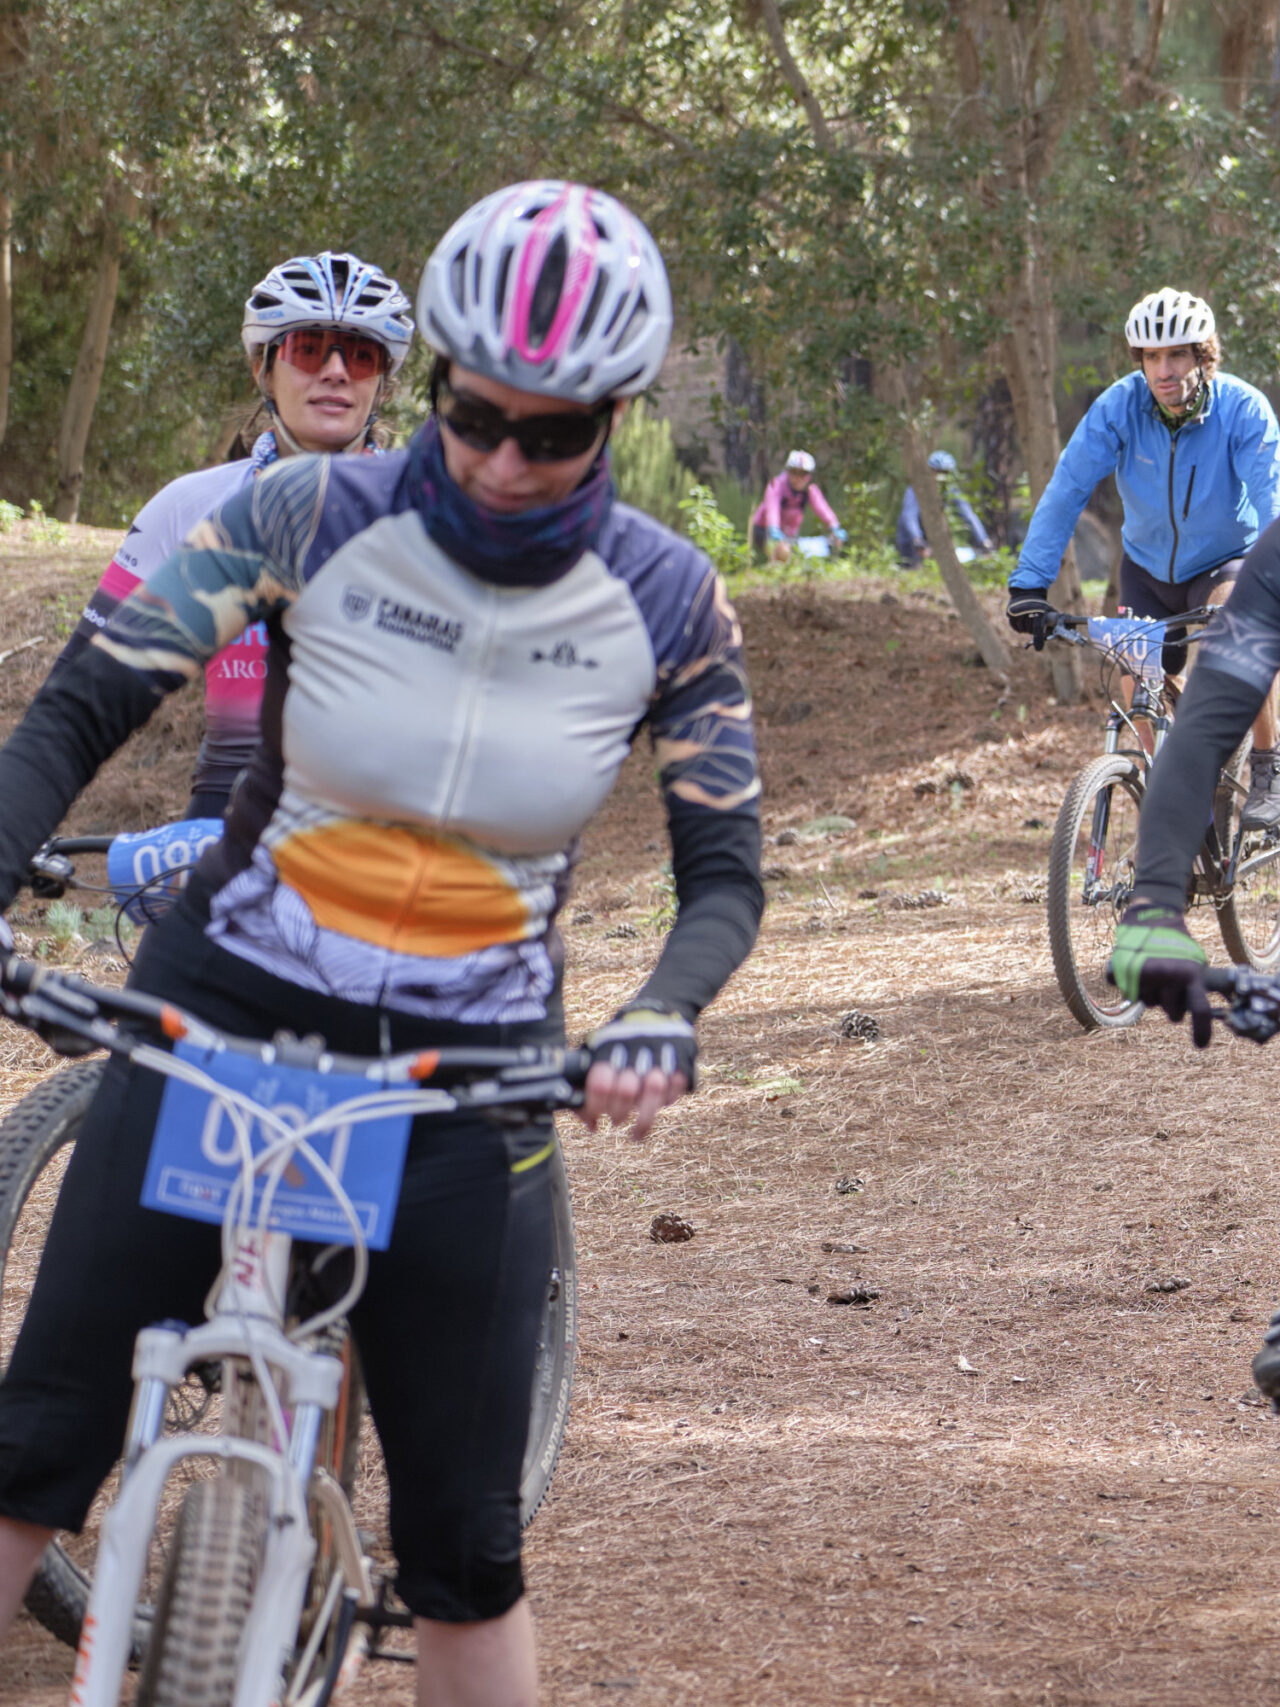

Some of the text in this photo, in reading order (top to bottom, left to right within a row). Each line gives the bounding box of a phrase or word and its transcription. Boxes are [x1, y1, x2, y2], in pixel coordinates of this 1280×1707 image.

[133, 835, 220, 894] 09
[540, 1377, 570, 1475] BONTRAGER
[564, 1312, 576, 1343] TEAM
